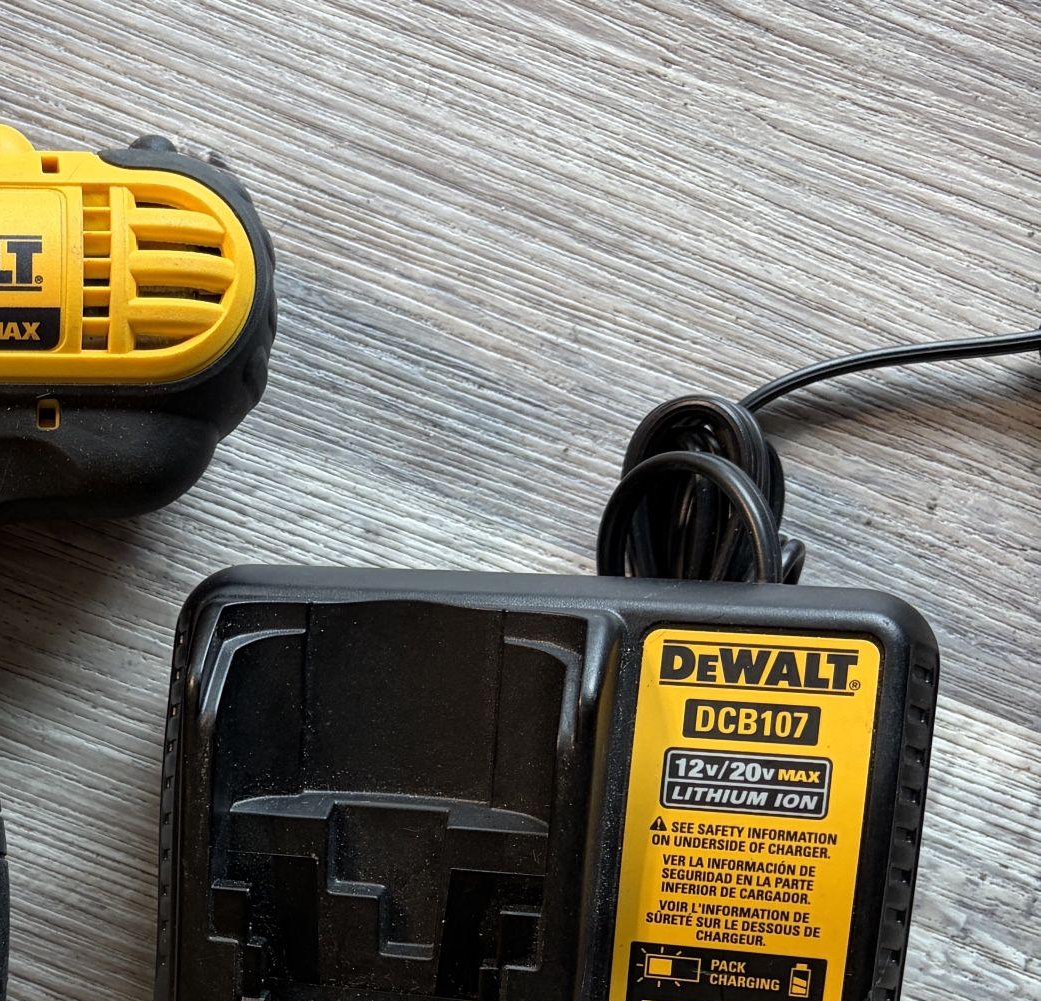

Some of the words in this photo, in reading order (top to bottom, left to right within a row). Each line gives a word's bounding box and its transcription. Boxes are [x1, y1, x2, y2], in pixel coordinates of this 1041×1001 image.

[694, 705, 809, 738] DCB107
[777, 768, 821, 784] MAX
[671, 785, 769, 806] LITHIUM
[774, 793, 819, 810] ION
[671, 821, 694, 834] SEE
[697, 823, 745, 838] SAFETY
[747, 827, 838, 845] INFORMATION
[651, 833, 670, 846] ON
[673, 836, 746, 853] UNDERSIDE
[749, 841, 765, 854] OF
[768, 843, 831, 859] CHARGER.
[662, 854, 686, 866] VER
[688, 856, 704, 868] LA
[707, 857, 796, 876] INFORMACIÓN
[799, 865, 816, 877] DE
[661, 867, 732, 884] SEGURIDAD
[735, 873, 753, 886] EN
[756, 875, 771, 888] LA
[774, 877, 814, 891] PARTE
[661, 881, 716, 897] INFERIOR
[720, 886, 736, 898] DE
[739, 888, 811, 905] CARGADOR.
[658, 900, 688, 913] VOIR
[691, 902, 790, 921] L'INFORMATION
[793, 912, 810, 923] DE
[645, 910, 693, 927] SÛRETÉ
[695, 916, 721, 930] SUR
[724, 919, 738, 931] LE
[741, 920, 800, 937] DESSOUS
[803, 926, 821, 939] DE
[695, 930, 767, 947] CHARGEUR.
[710, 959, 747, 973] PACK
[709, 973, 781, 991] CHARGING
